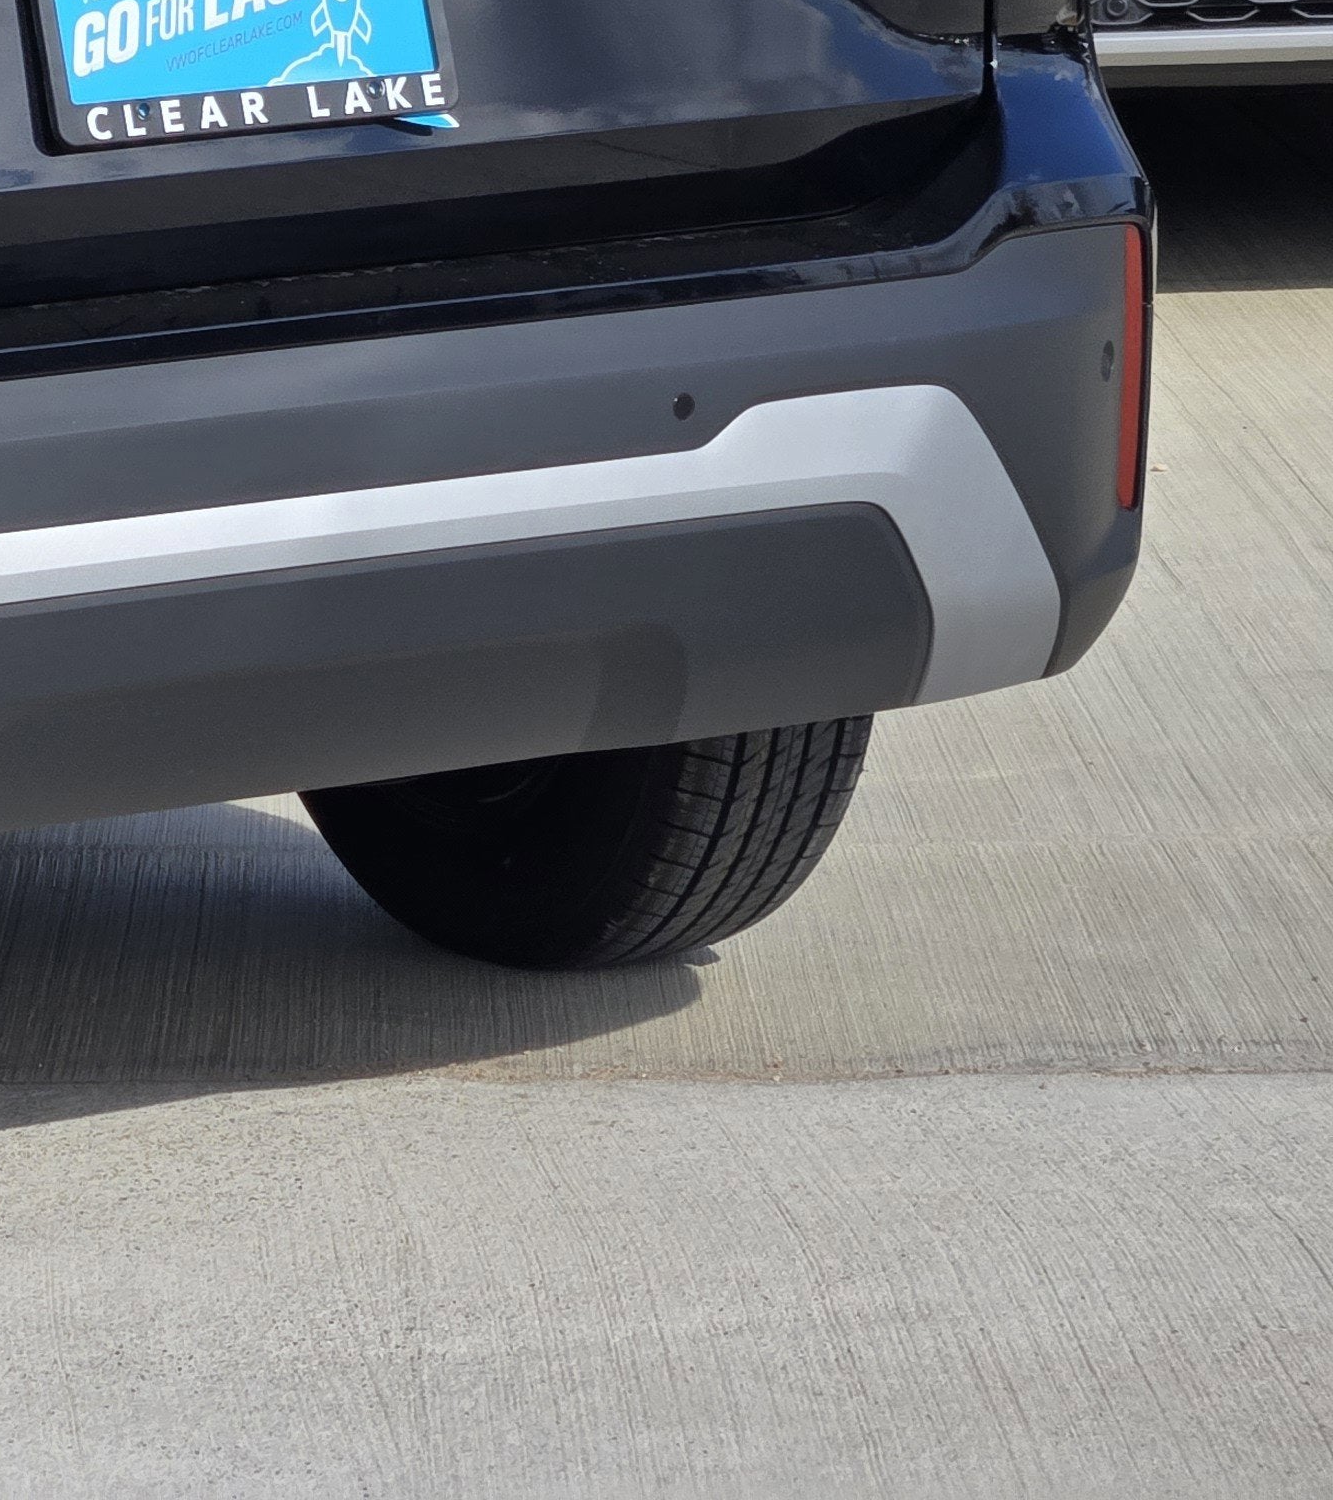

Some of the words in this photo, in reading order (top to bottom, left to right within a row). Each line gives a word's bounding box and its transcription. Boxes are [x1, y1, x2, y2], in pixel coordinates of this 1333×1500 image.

[164, 10, 304, 73] VWOFCLEARLAKE.COM
[85, 91, 270, 140] CLEAR
[305, 73, 447, 119] LAKE
